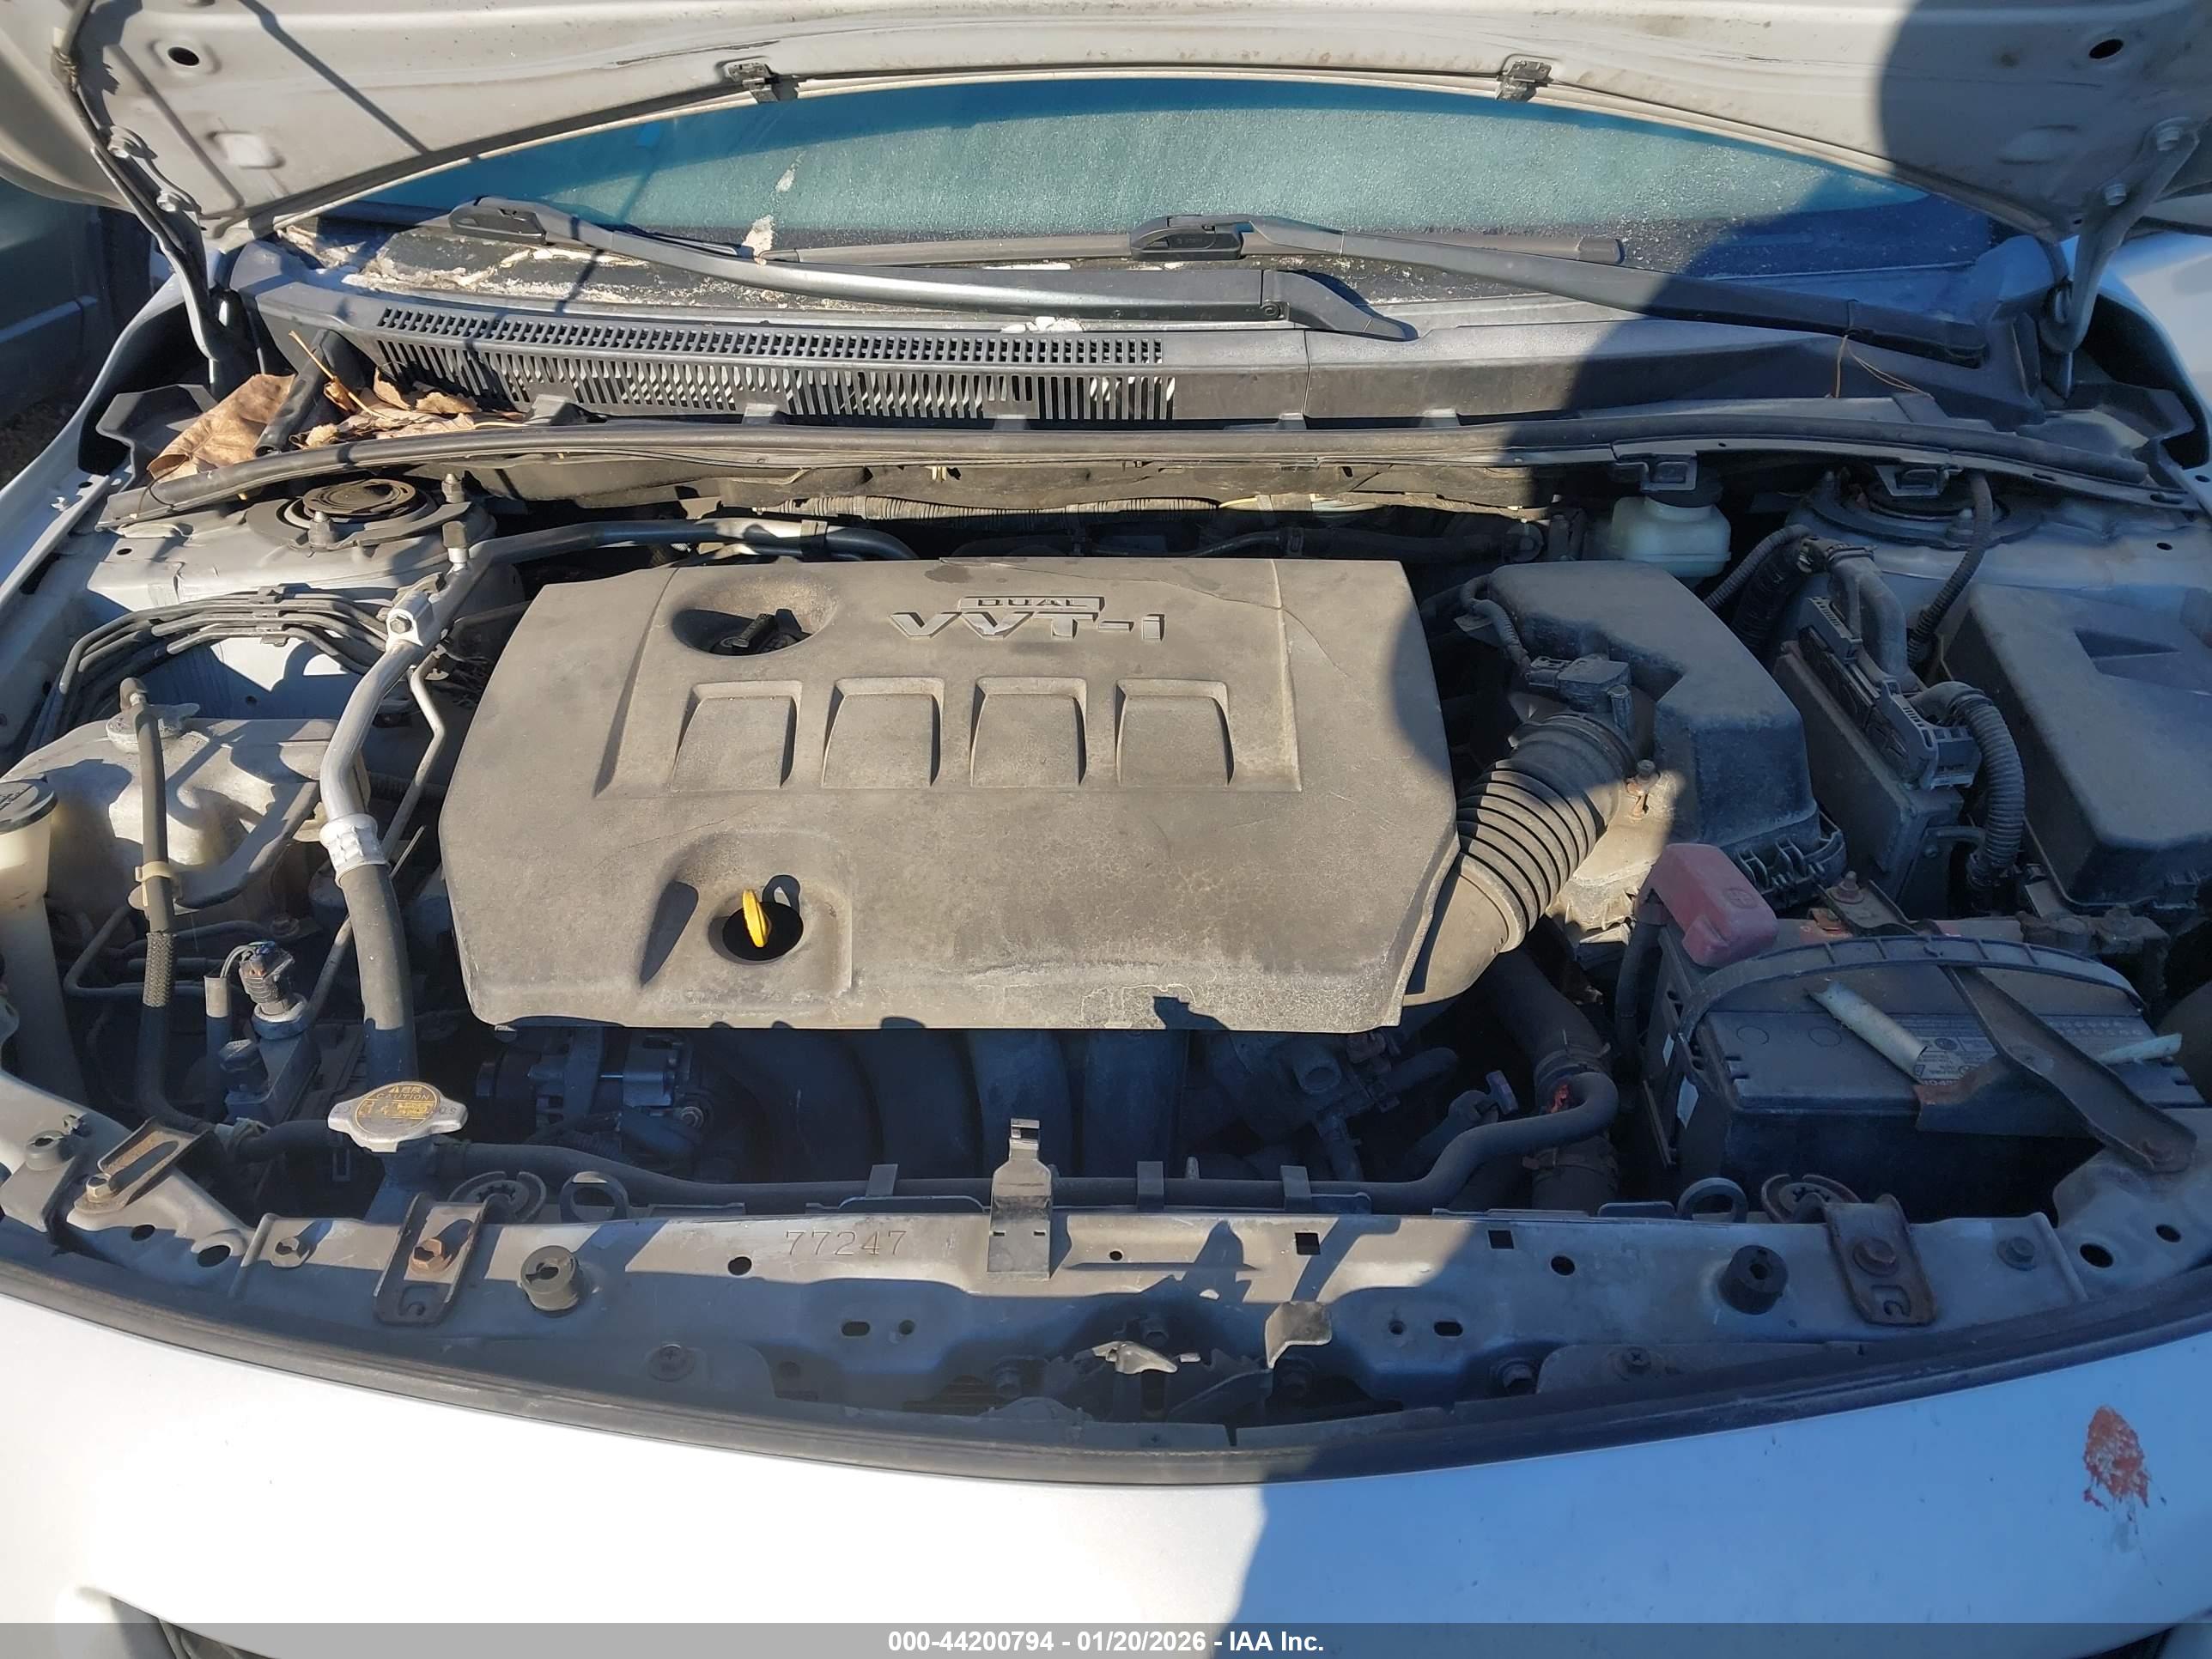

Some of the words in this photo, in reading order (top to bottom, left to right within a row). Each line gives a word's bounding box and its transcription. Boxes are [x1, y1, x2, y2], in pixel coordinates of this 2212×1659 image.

[977, 599, 1091, 609] DUAL
[376, 1093, 431, 1102] CAUTION
[785, 1230, 907, 1255] 77247
